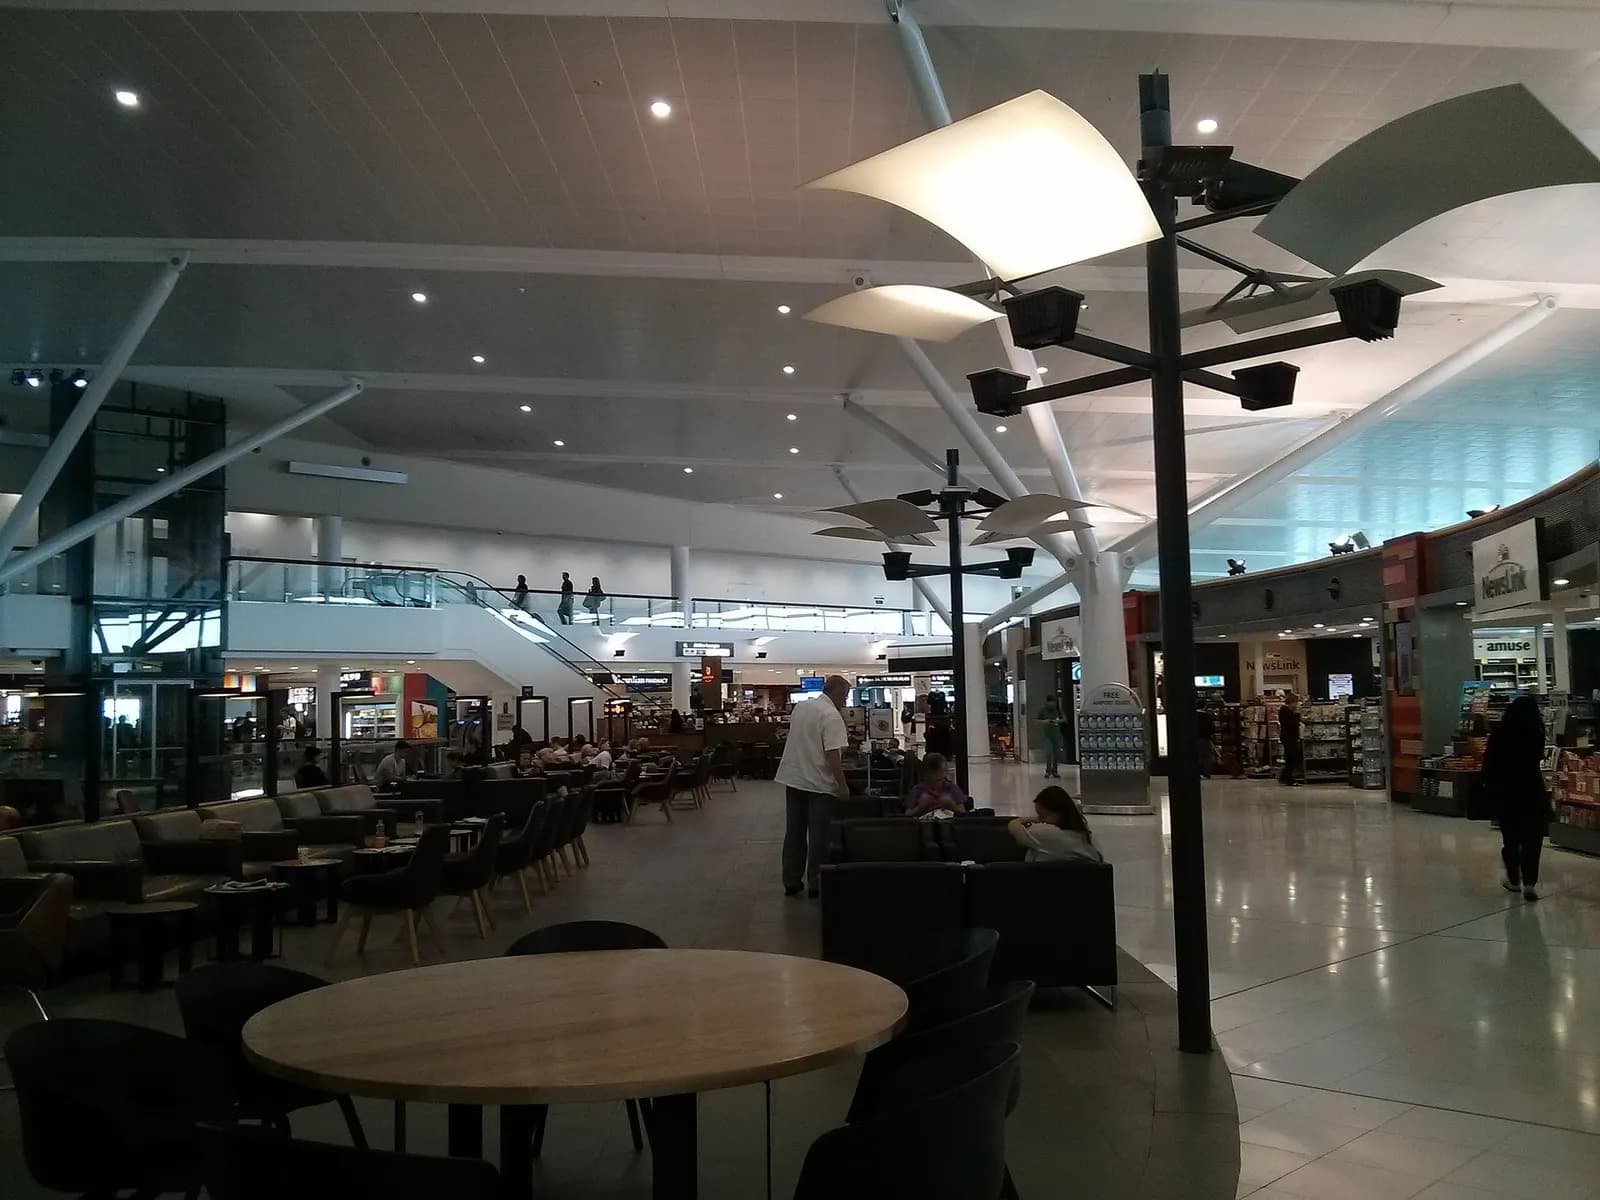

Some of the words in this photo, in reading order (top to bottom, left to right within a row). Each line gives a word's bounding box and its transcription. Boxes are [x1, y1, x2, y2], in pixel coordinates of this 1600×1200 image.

[1482, 566, 1528, 600] NewsLink
[1487, 641, 1531, 651] amuse
[1246, 659, 1301, 671] NwsLink
[1103, 691, 1121, 699] FREE
